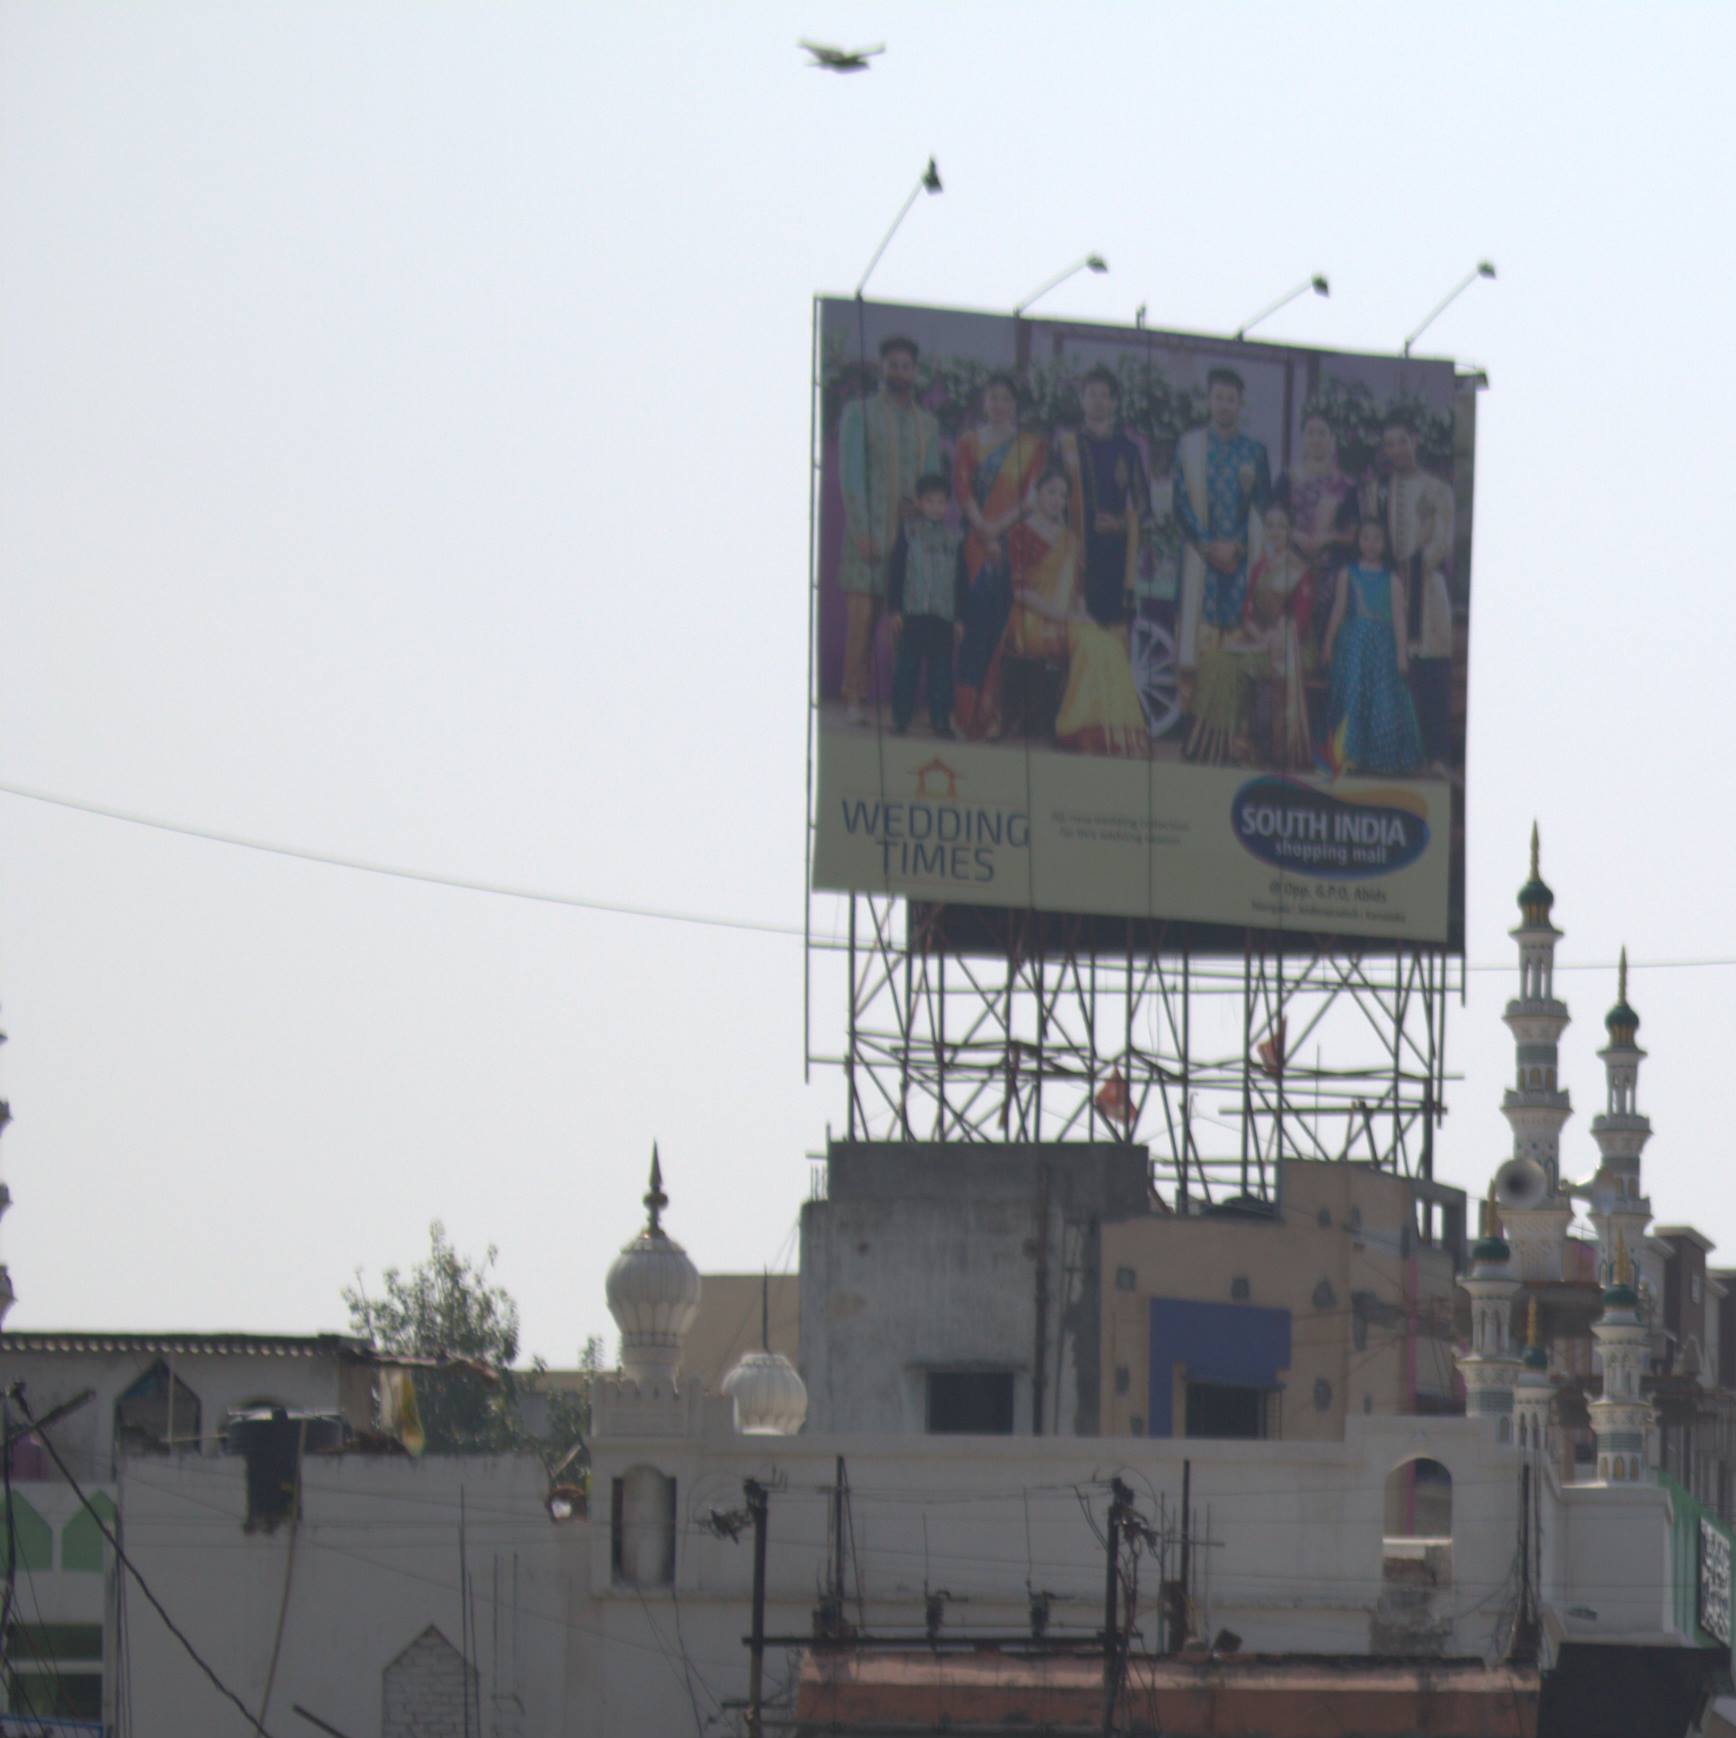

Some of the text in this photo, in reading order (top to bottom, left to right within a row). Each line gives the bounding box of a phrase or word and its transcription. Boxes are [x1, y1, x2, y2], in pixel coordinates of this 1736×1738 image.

[841, 798, 1031, 848] WEDDING
[1240, 805, 1408, 848] SOUTH INDIA
[876, 840, 996, 883] TIMES
[1274, 841, 1388, 867] shopping mall
